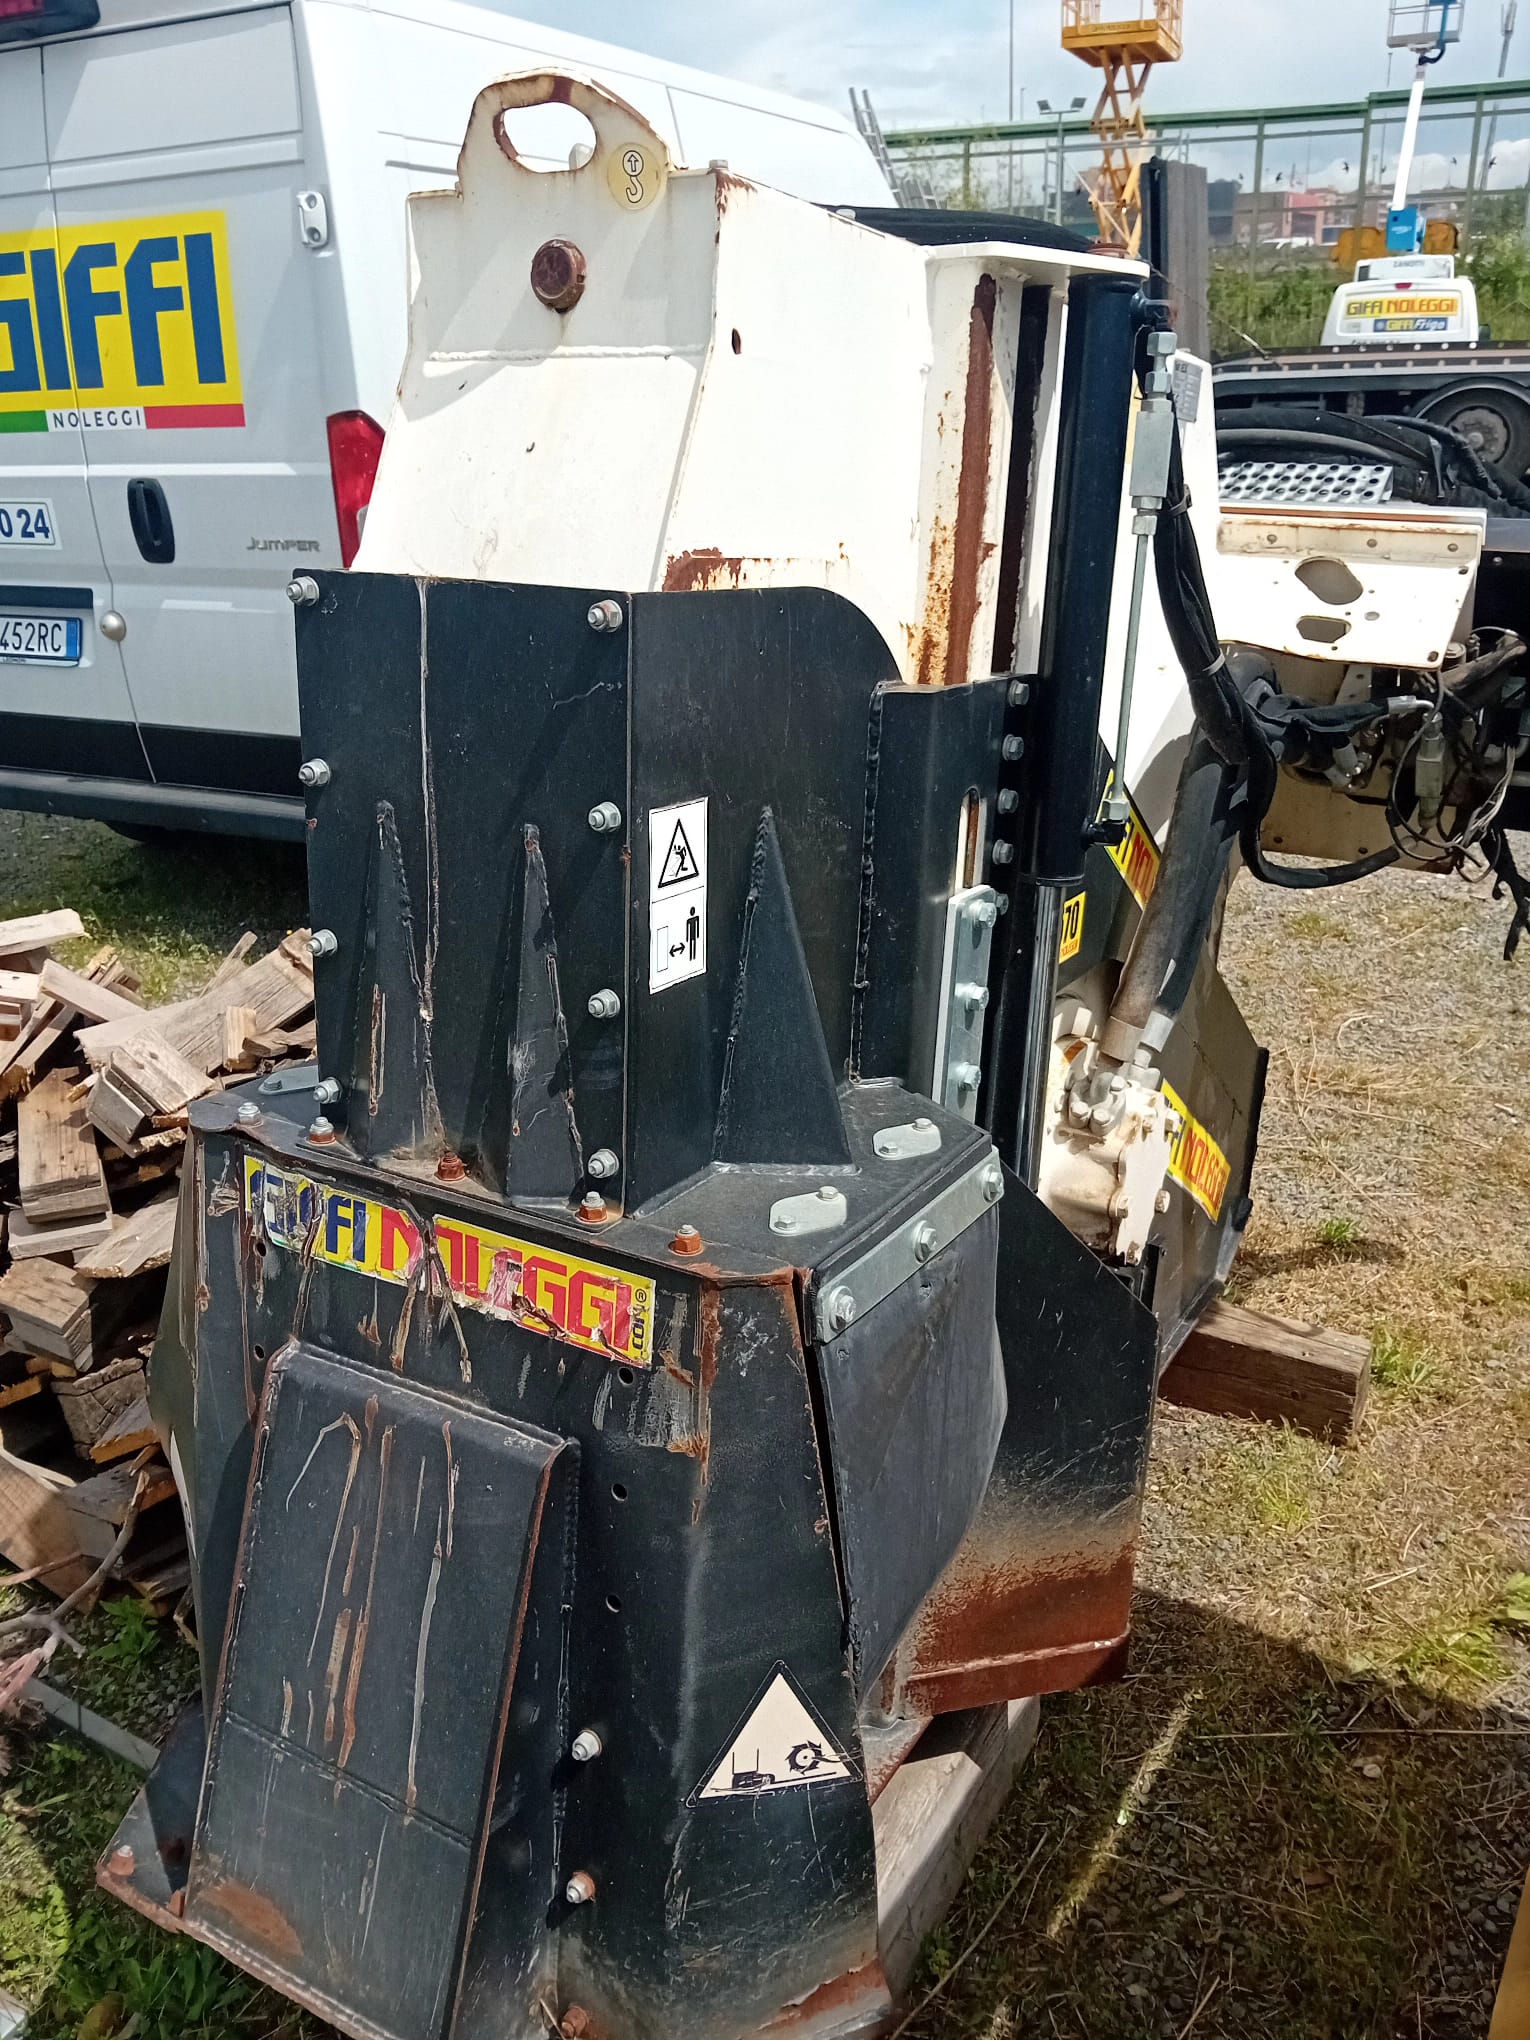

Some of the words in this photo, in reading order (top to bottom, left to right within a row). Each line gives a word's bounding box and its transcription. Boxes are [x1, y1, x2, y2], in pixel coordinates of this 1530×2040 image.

[1347, 301, 1382, 315] GIFFI
[1387, 298, 1455, 313] NOLEGGI
[53, 409, 141, 428] NOLEGGI
[1063, 900, 1080, 944] 70
